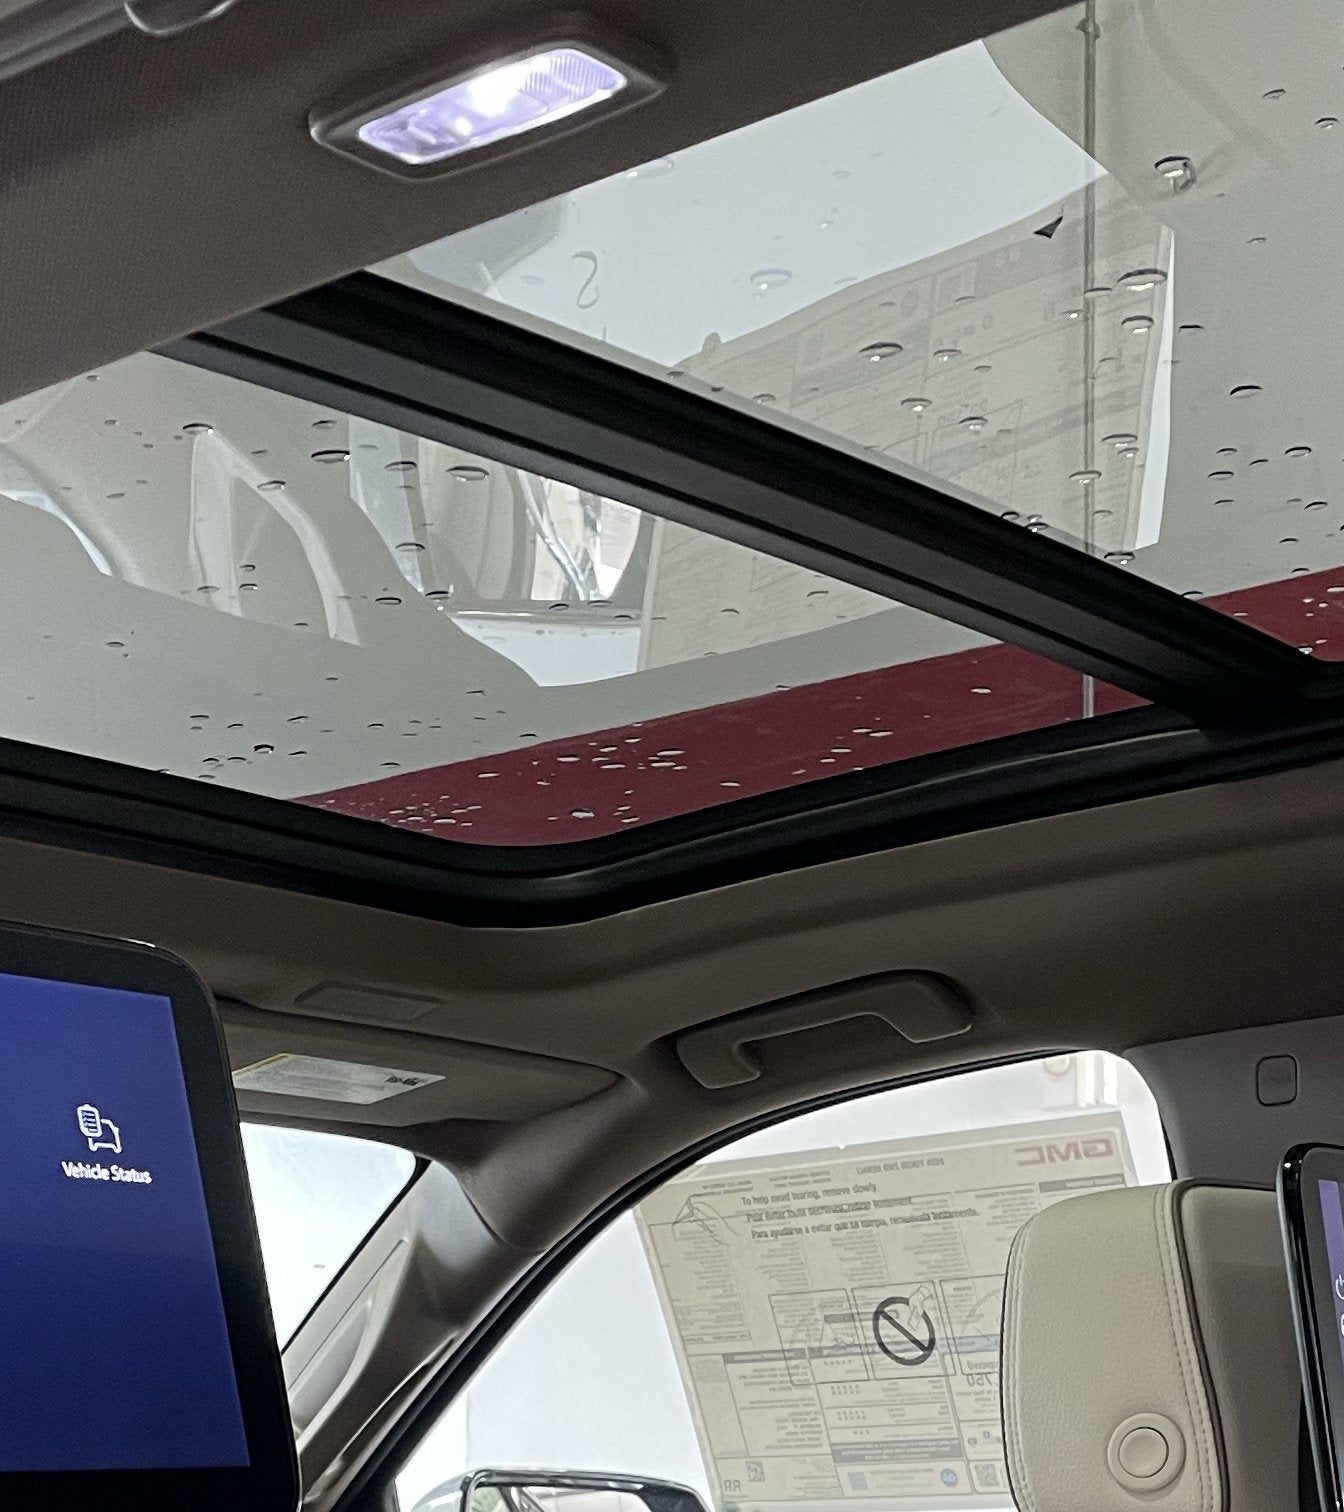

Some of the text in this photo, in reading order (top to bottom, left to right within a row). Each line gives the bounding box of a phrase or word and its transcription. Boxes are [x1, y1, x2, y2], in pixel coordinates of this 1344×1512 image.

[61, 1160, 153, 1184] Vehicle Status
[742, 1196, 752, 1206] To
[851, 1182, 877, 1194] slowly
